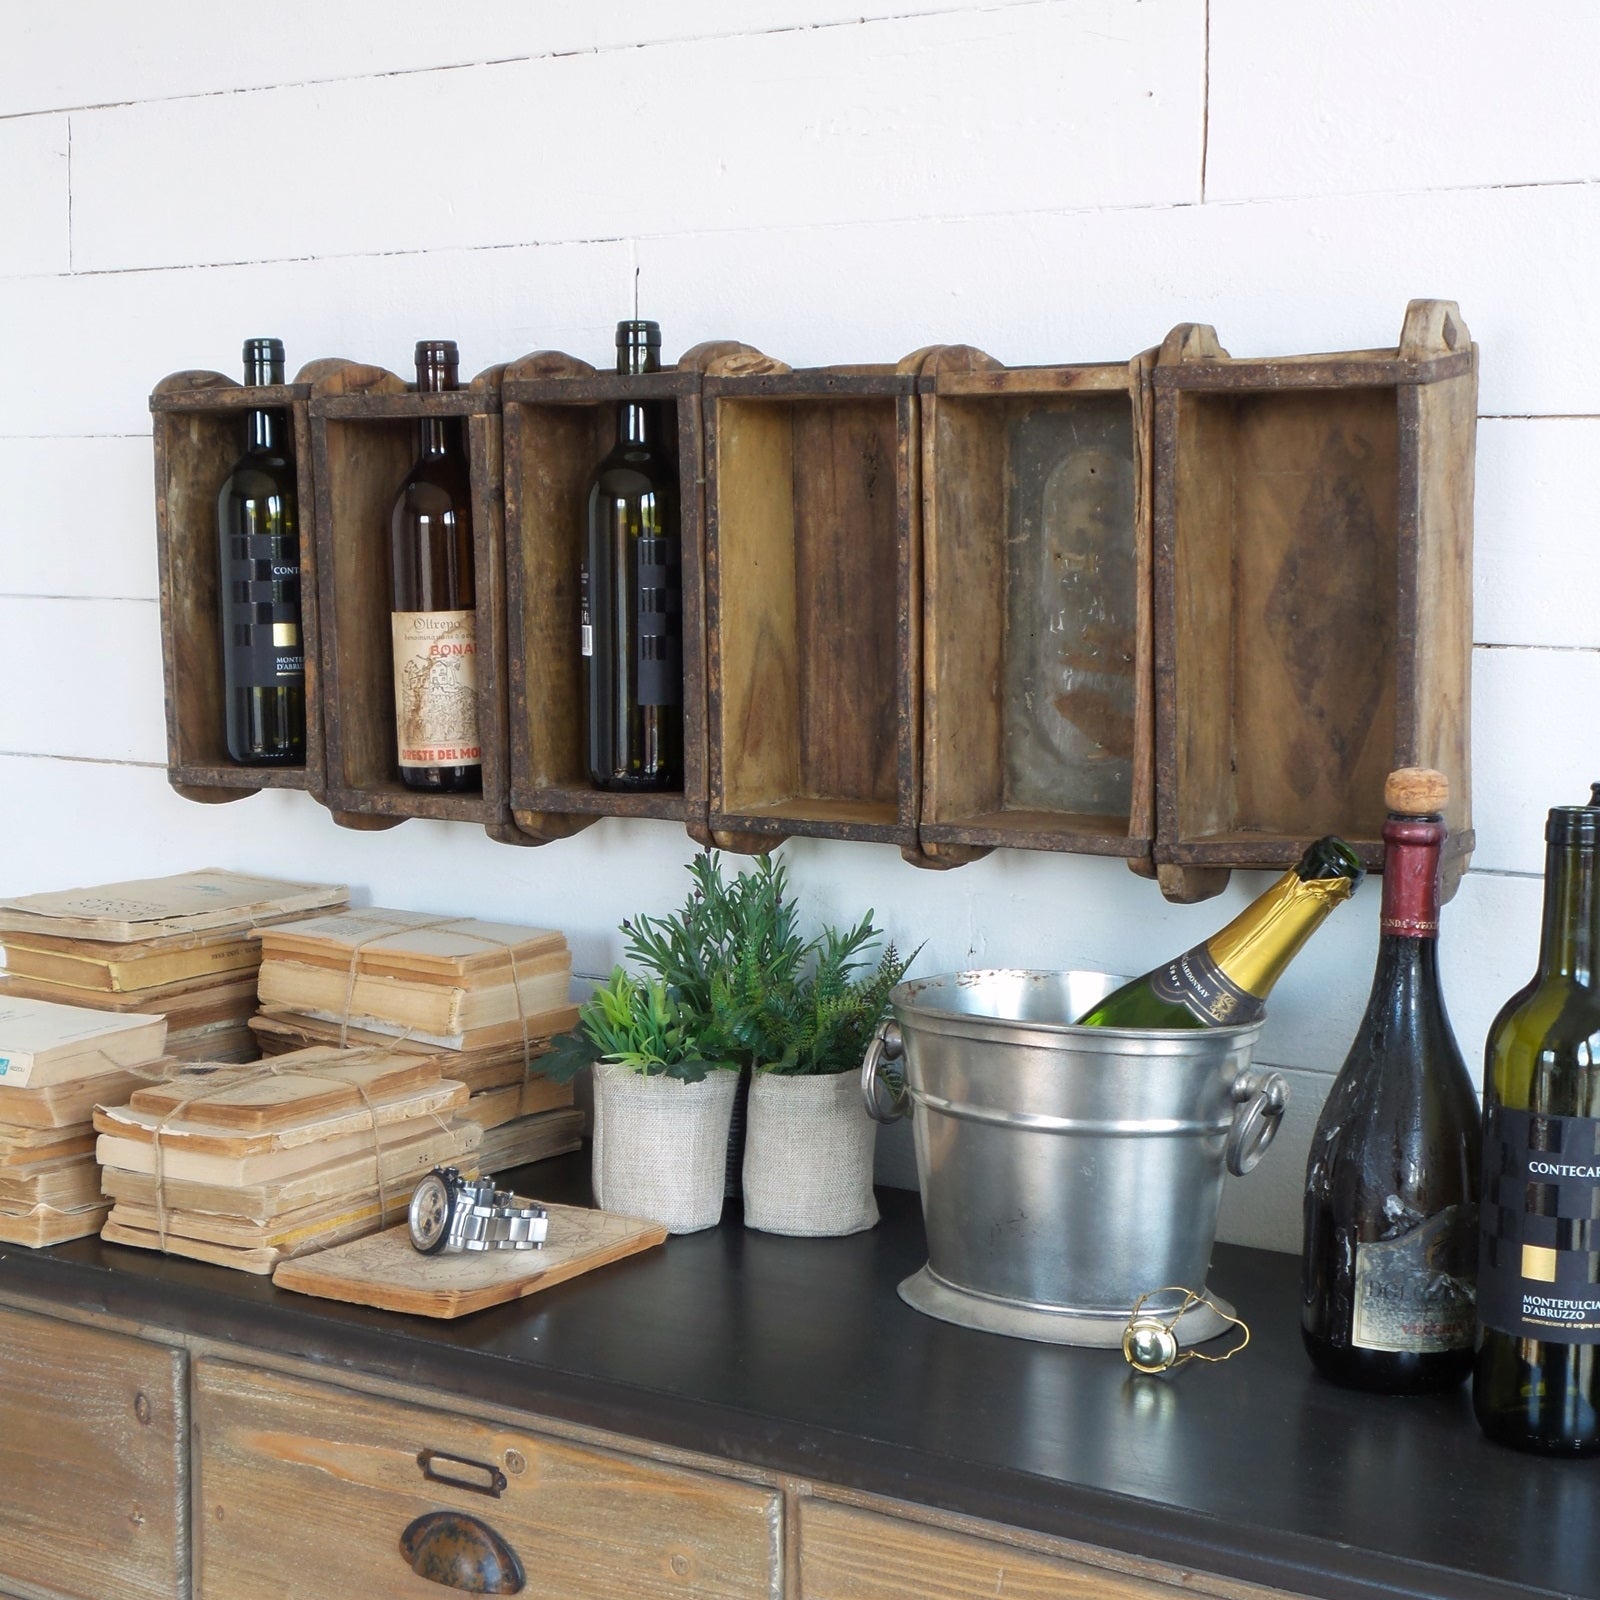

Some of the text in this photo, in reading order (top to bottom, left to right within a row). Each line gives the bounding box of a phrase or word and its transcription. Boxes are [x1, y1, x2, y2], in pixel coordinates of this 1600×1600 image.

[402, 749, 434, 761] ORESTE
[437, 749, 458, 760] DEL
[1522, 1304, 1586, 1320] D'ABRUZZO
